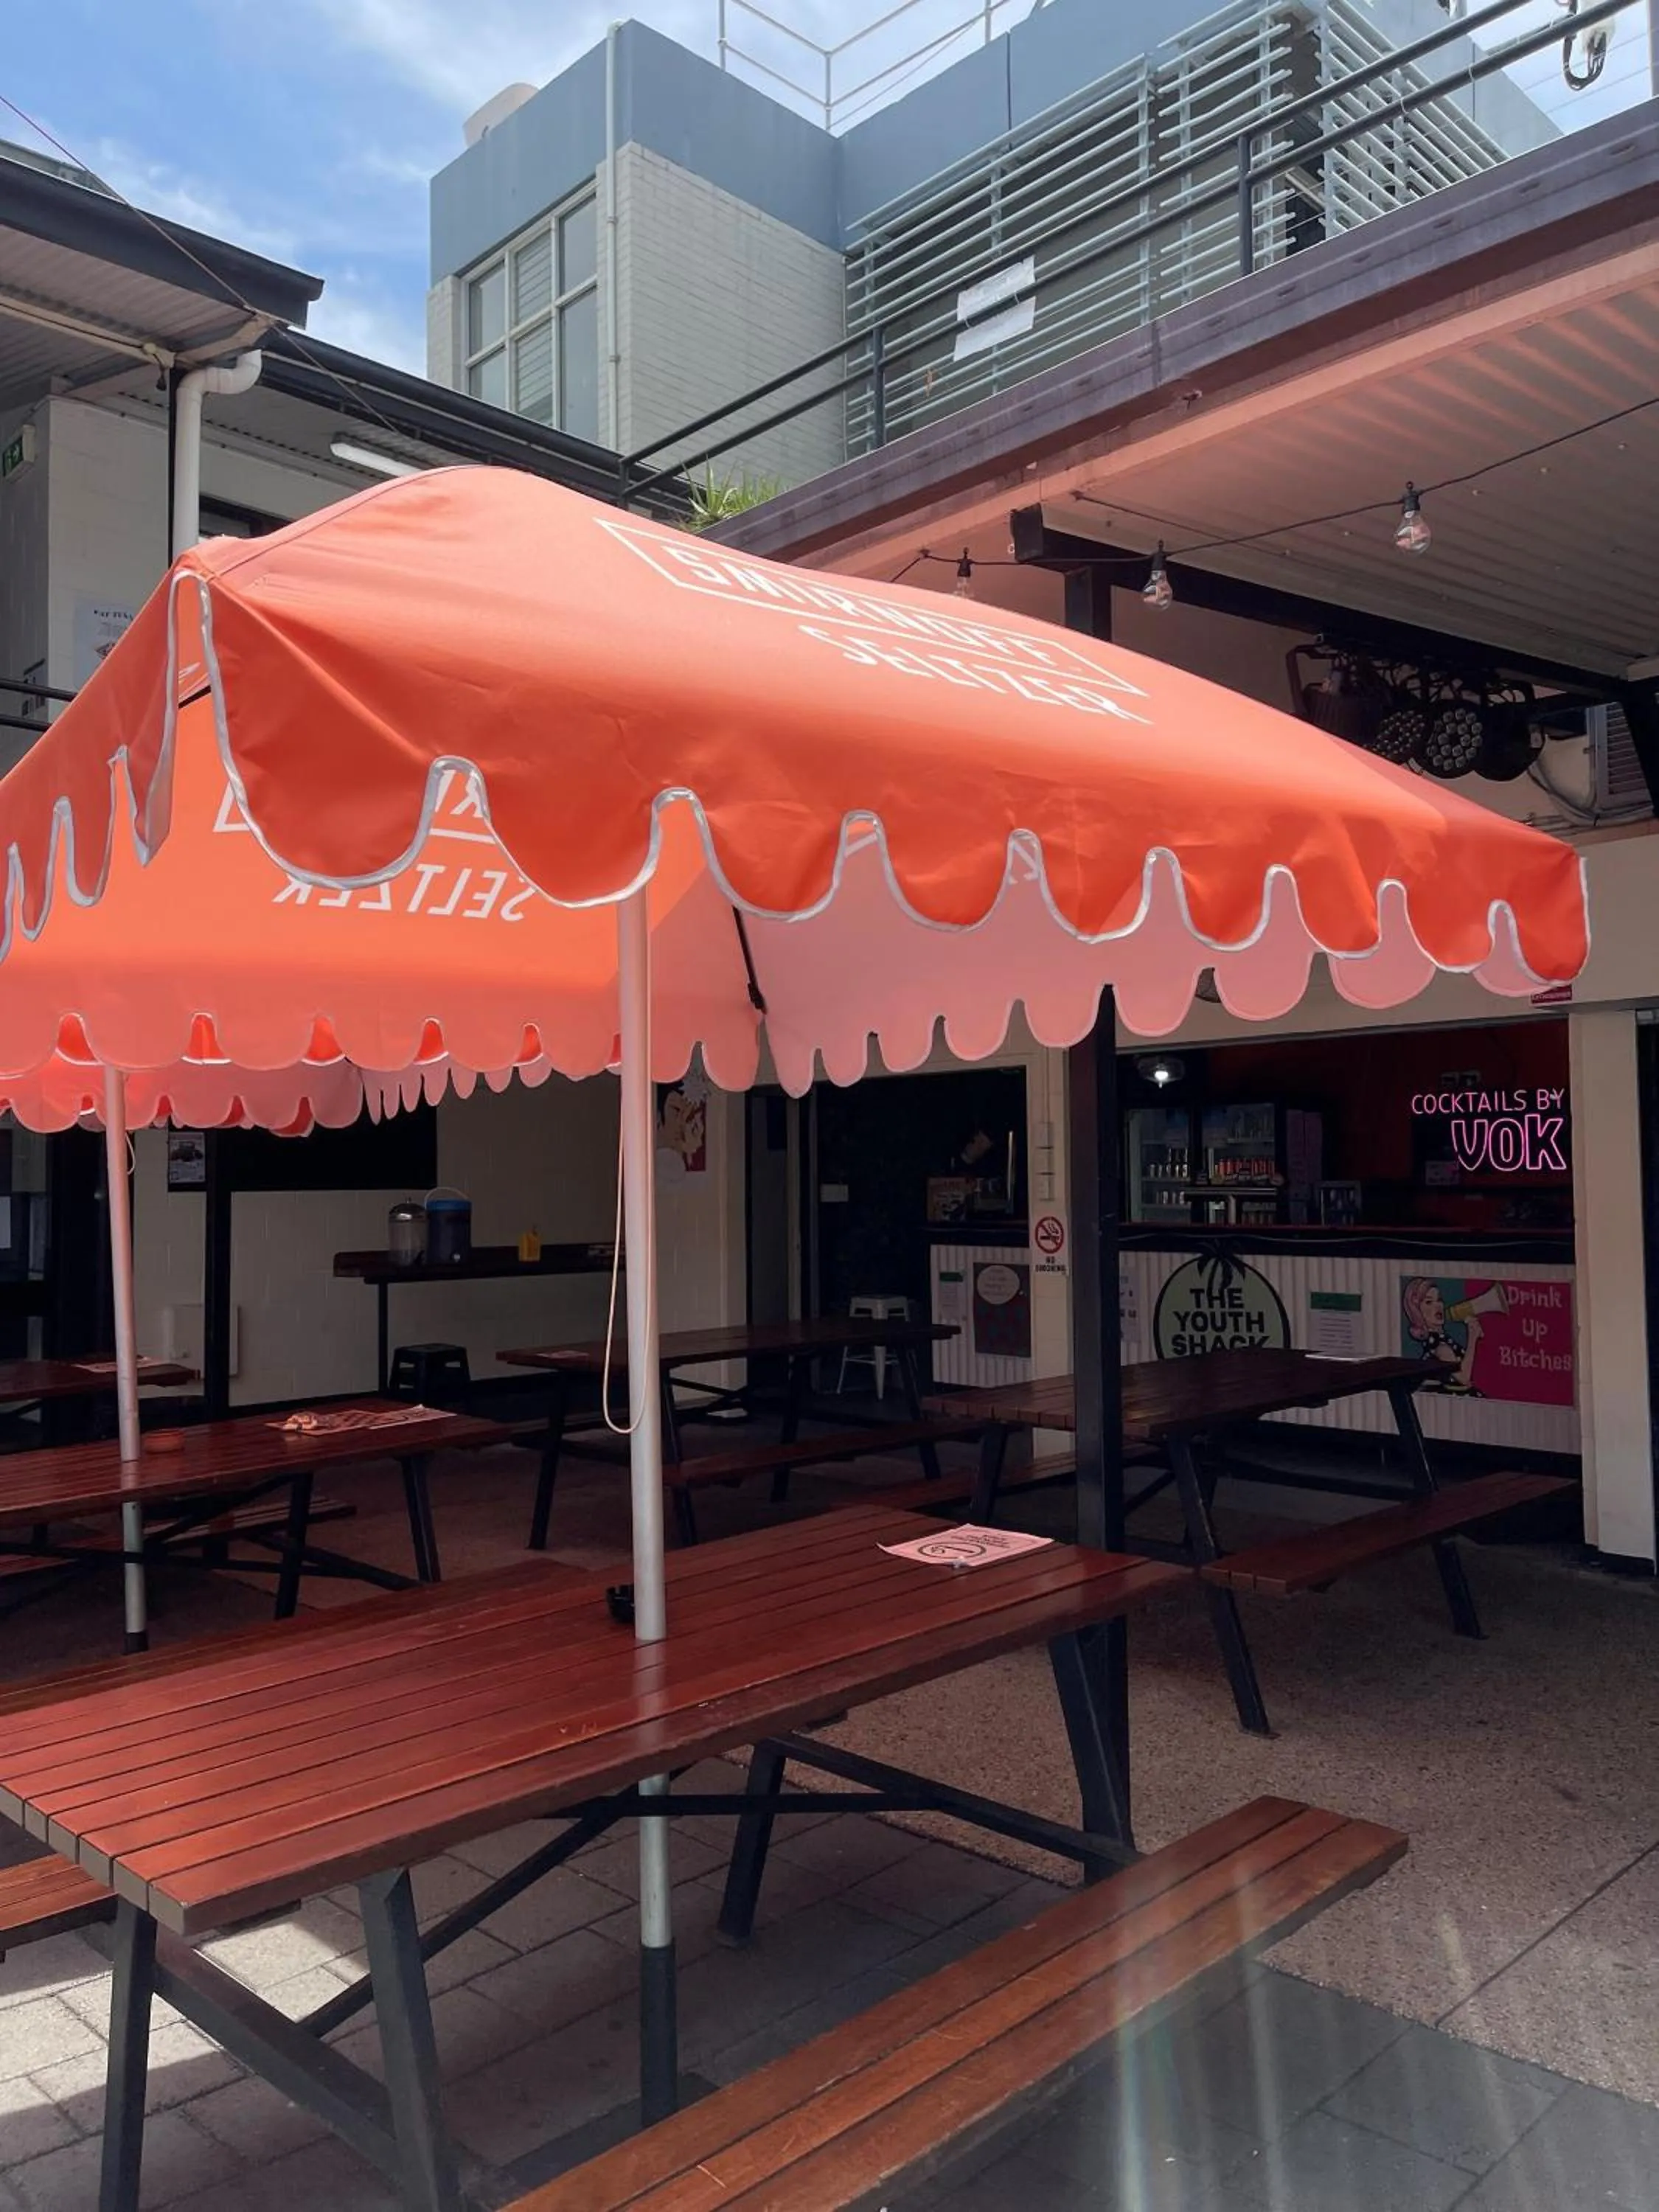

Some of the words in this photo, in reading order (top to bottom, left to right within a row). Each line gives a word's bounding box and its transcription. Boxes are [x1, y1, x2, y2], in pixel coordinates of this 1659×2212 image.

[800, 625, 1153, 725] SELTZER
[1411, 1089, 1528, 1115] COCKTAILS
[1536, 1087, 1565, 1110] BY
[1450, 1113, 1568, 1172] VOK
[1189, 1288, 1244, 1309] THE
[1507, 1284, 1562, 1308] Drink
[1172, 1311, 1265, 1333] YOUTH
[1522, 1319, 1548, 1343] Up
[1499, 1345, 1573, 1371] Bitches
